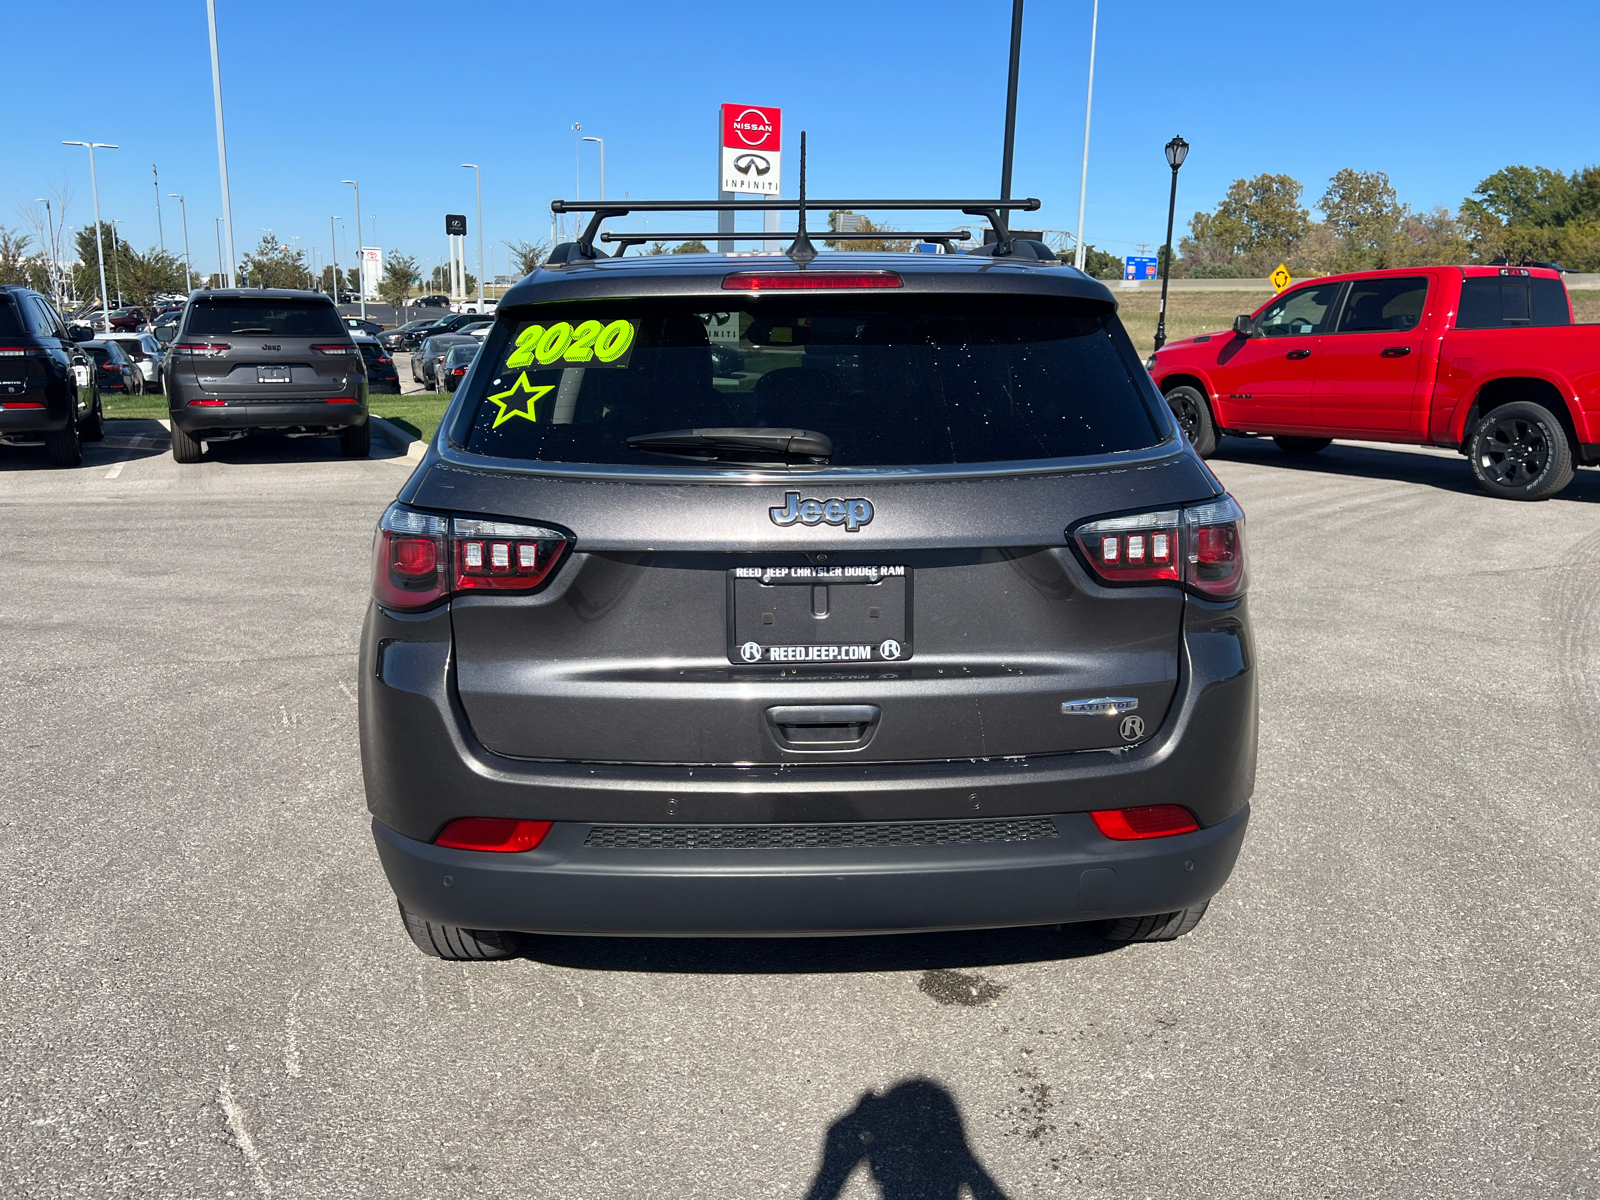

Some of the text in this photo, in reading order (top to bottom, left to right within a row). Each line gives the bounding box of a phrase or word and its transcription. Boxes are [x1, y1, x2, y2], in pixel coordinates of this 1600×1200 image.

[733, 122, 772, 132] NISSAN
[725, 179, 778, 191] INFINITI
[506, 320, 634, 368] 2020
[769, 491, 874, 532] Jeep
[736, 566, 905, 577] REED JEEP CHRYSLER DODGE RAM
[770, 646, 871, 661] REEDJEEP.COM
